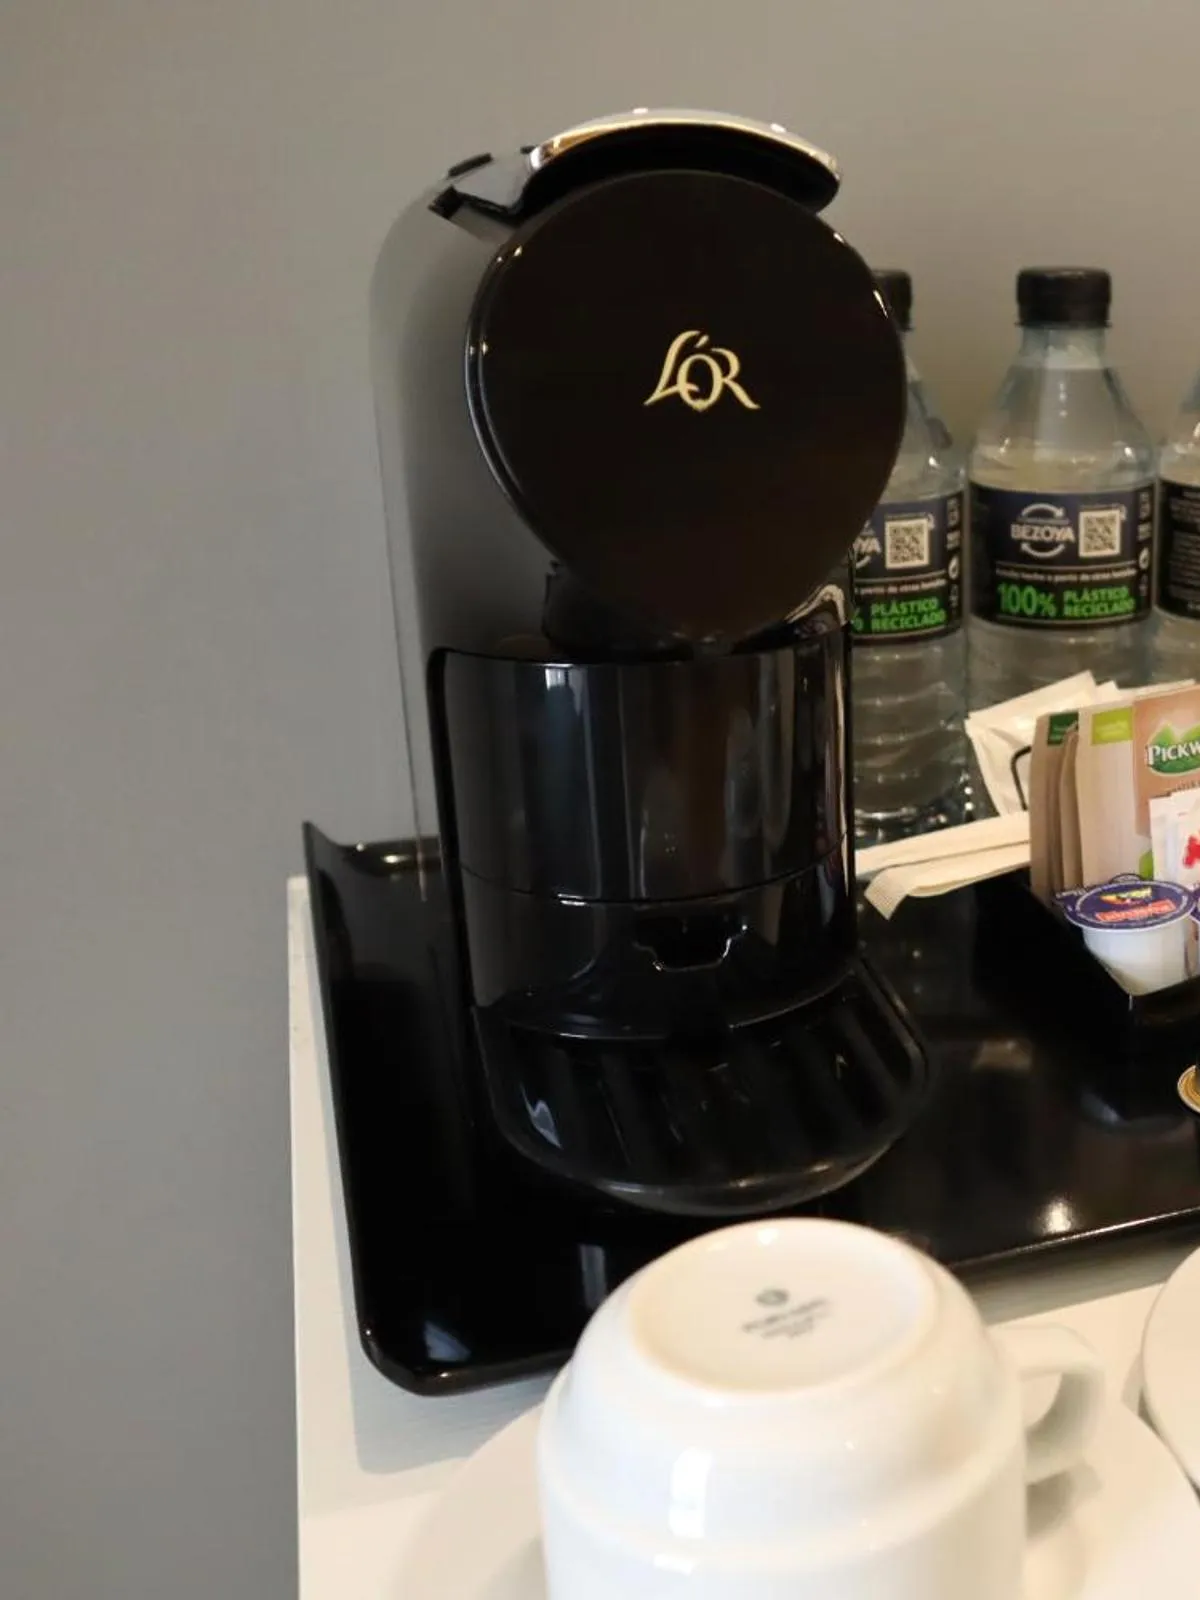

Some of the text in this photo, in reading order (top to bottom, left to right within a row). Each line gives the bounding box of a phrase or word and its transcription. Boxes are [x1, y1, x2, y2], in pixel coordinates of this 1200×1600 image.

[1010, 523, 1076, 543] BEZOYA
[998, 583, 1057, 617] 100%
[1063, 585, 1130, 603] PLÁSTICO
[871, 597, 939, 618] PLÁSTICO
[1063, 597, 1136, 617] RECICLADO
[871, 609, 947, 632] RECICLADO
